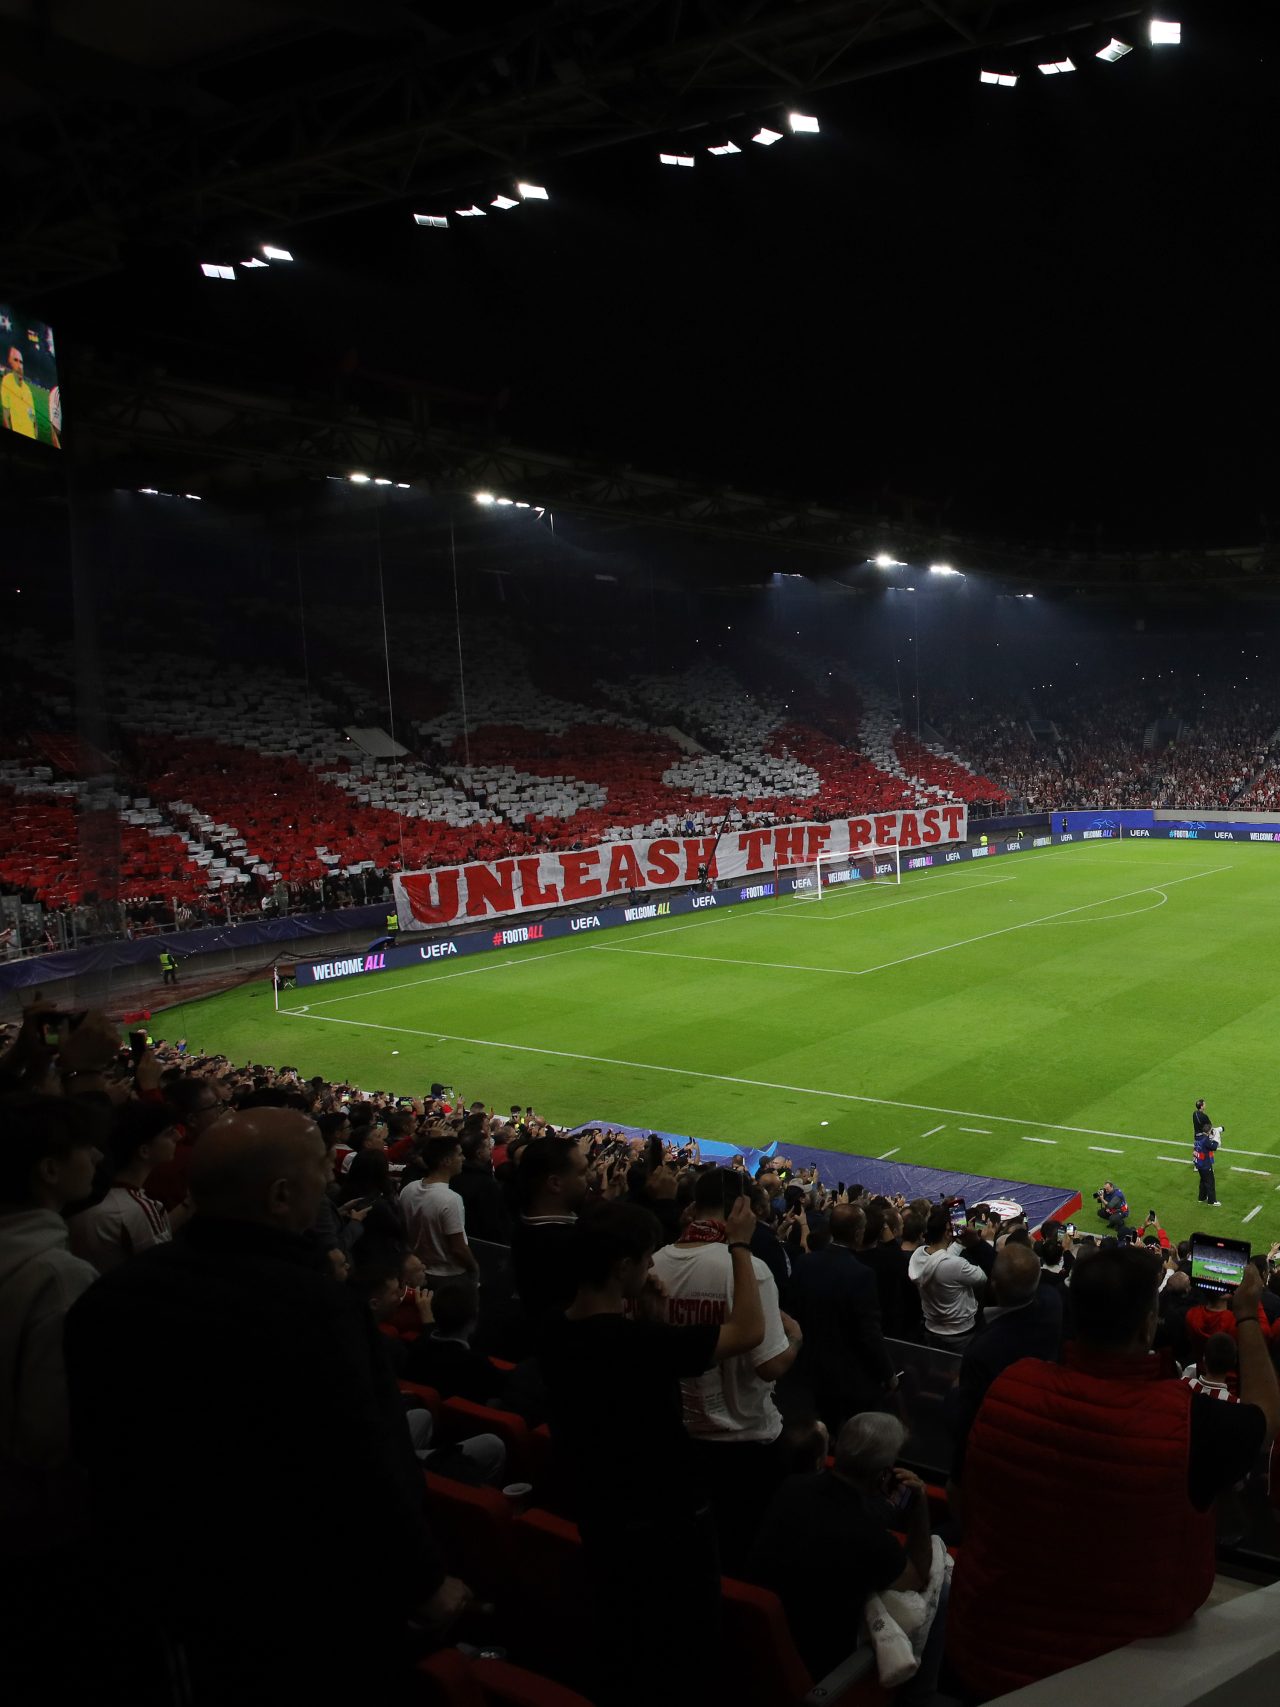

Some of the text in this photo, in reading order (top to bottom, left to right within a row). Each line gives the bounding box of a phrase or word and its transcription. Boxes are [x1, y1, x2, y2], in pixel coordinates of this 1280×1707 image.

[1060, 833, 1073, 842] UEFA
[1130, 829, 1150, 837] UEFA
[1214, 831, 1234, 840] UEFA
[1250, 832, 1274, 841] WELCOME
[1006, 842, 1021, 851] UEFA
[945, 851, 960, 862] UEFA
[401, 806, 965, 924] UNLEASH THE BEAST
[876, 863, 893, 874] UEFA
[791, 878, 812, 890] UEFA
[740, 883, 774, 899] #FOOTBALL
[692, 895, 717, 908] UEFA
[624, 901, 671, 922] WELCOME ALL
[571, 915, 601, 931] UEFA
[492, 924, 545, 946] #FOOTBALL
[420, 941, 457, 959] UEFA
[312, 953, 386, 981] WELCOME ALL
[668, 1298, 726, 1325] ICTION
